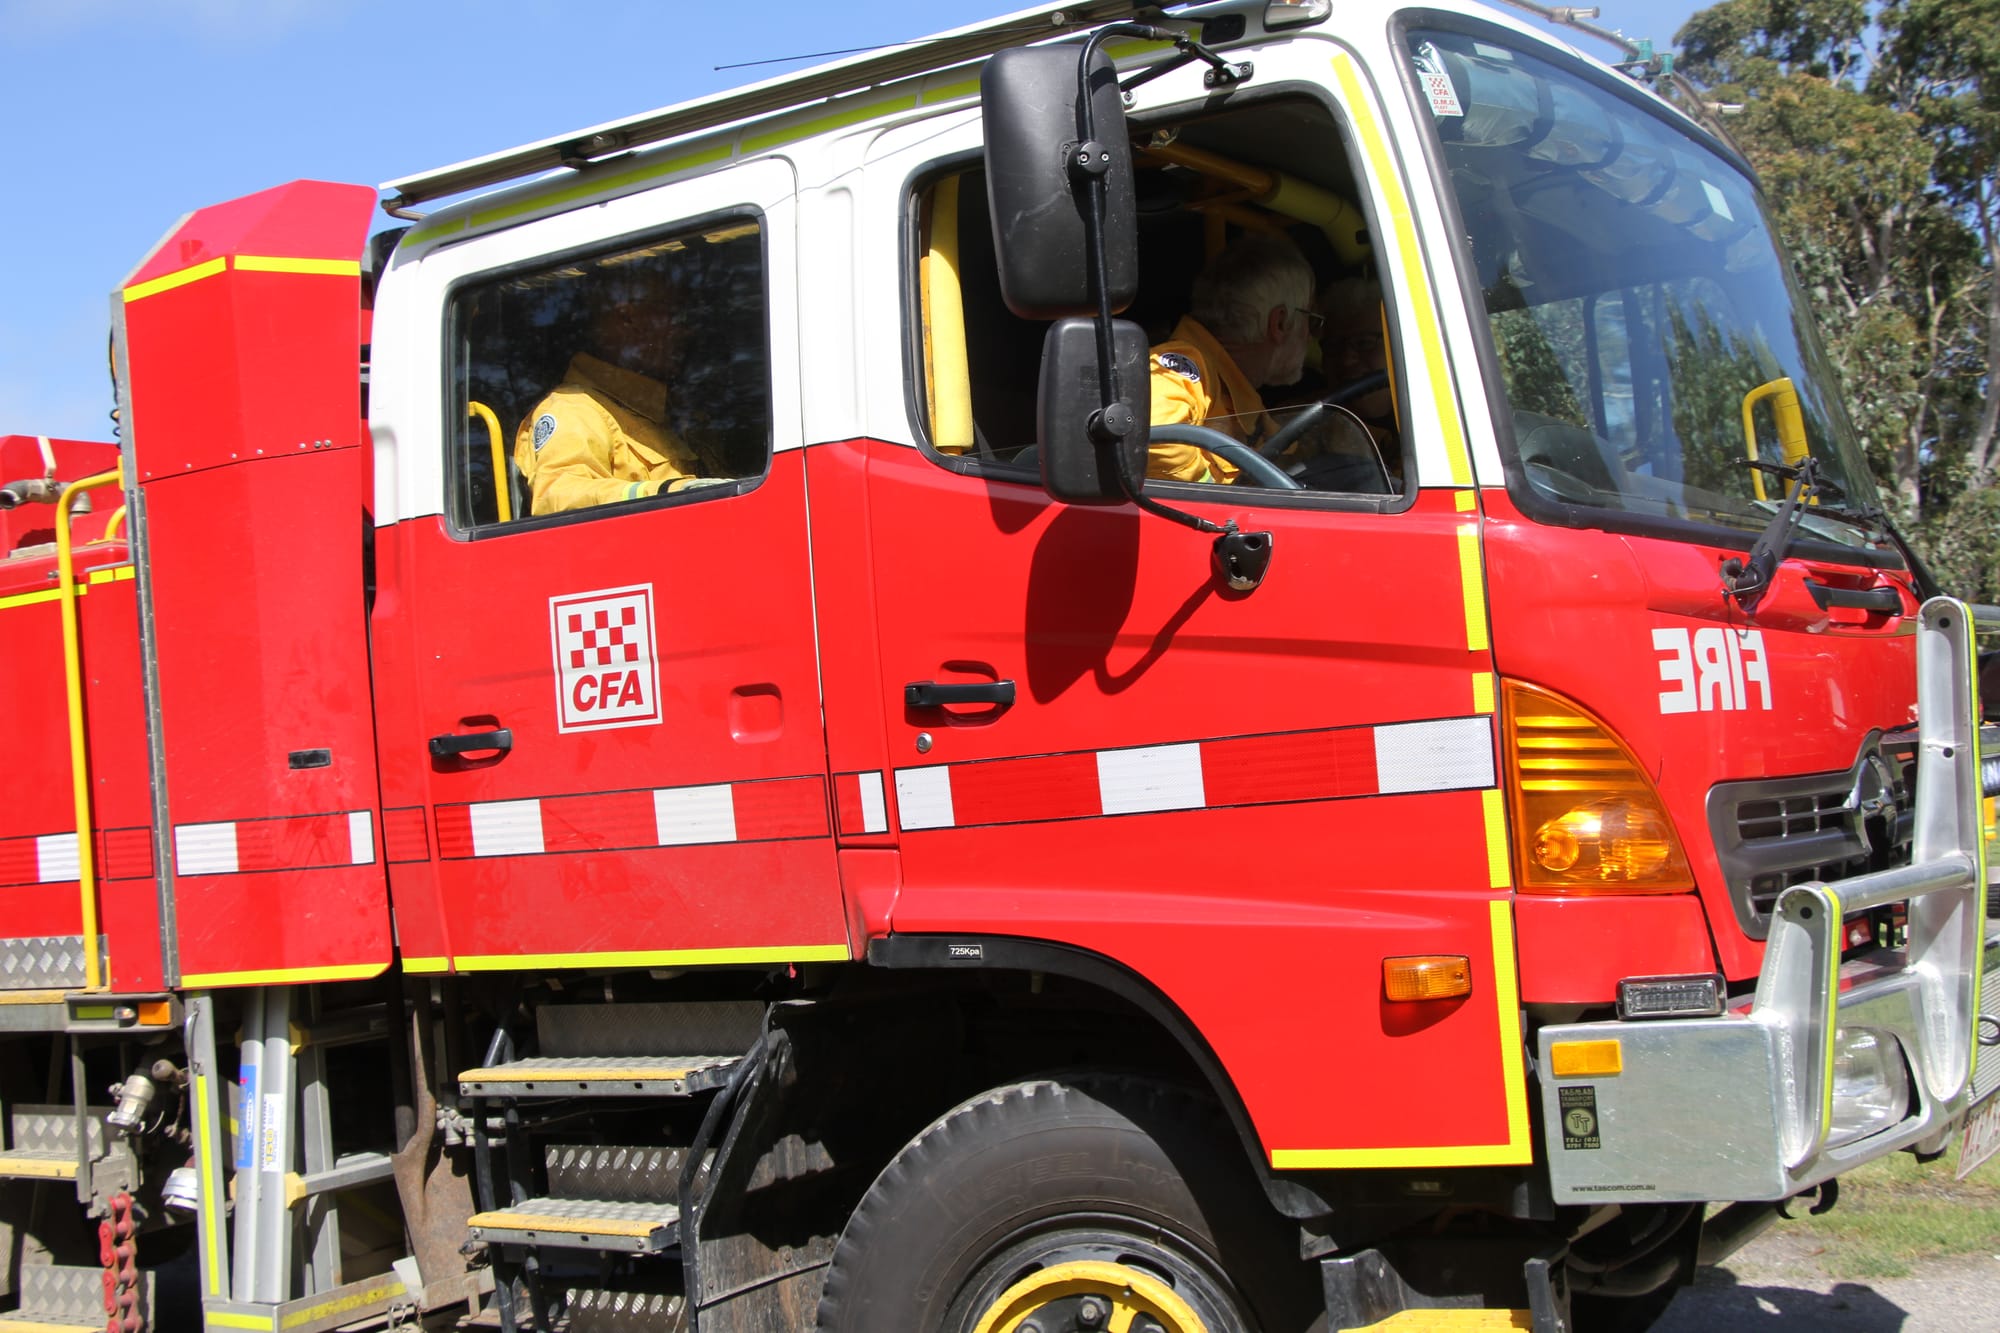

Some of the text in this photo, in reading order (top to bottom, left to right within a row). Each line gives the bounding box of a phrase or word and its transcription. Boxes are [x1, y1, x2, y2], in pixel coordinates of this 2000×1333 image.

[1433, 88, 1449, 96] CFA
[572, 669, 644, 712] CFA
[950, 947, 980, 957] 725Kpa
[1571, 1183, 1656, 1192] www.tascom.com.au
